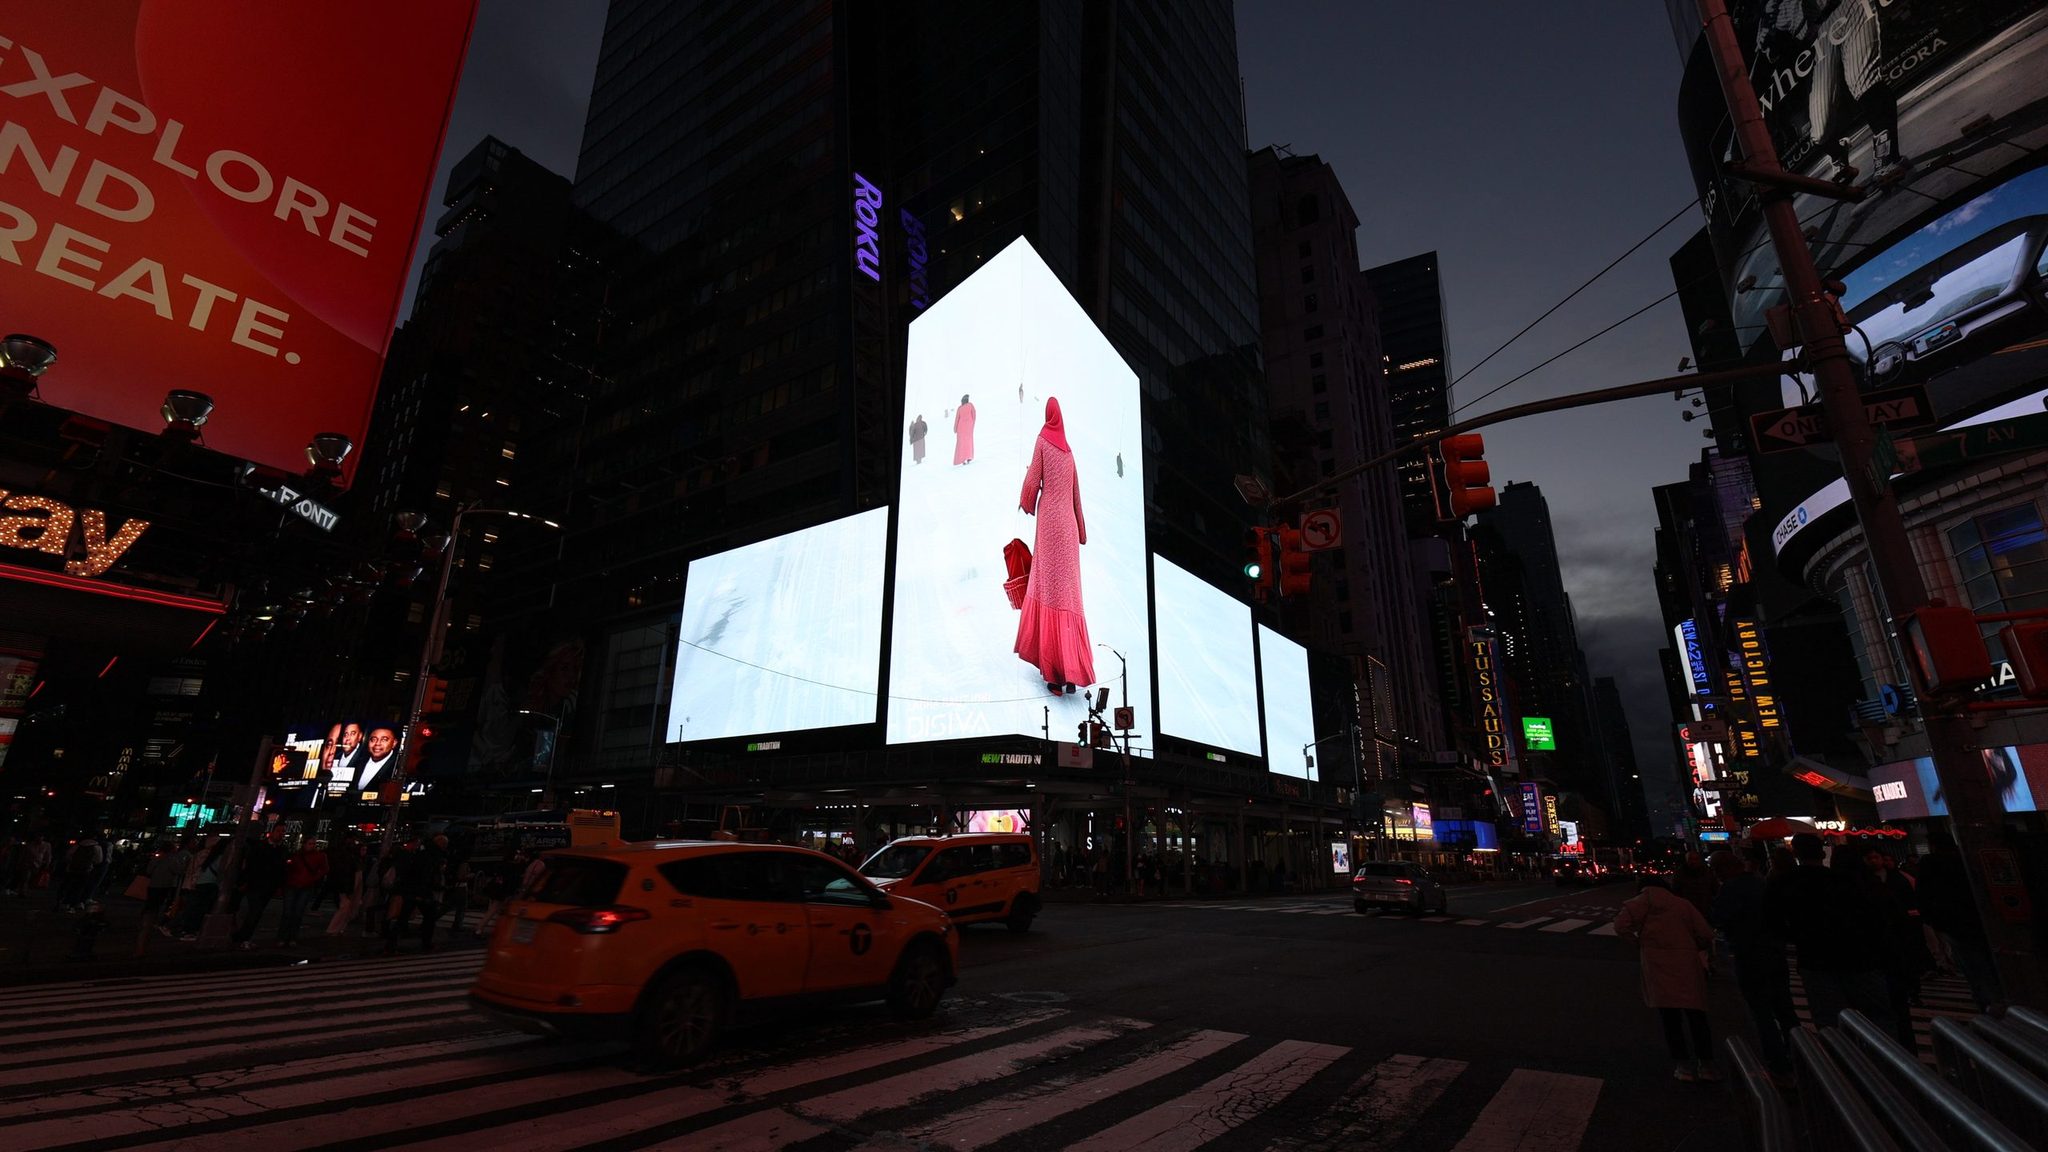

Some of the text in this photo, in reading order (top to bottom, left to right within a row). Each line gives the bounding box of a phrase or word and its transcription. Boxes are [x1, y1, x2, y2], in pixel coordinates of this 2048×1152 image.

[0, 35, 378, 258] XPLORE
[1865, 401, 1904, 425] AY
[0, 489, 152, 577] ay
[1776, 514, 1799, 545] CHASE
[1681, 618, 1698, 640] NEW
[1736, 620, 1780, 728] NEW VICTORY
[1740, 731, 1760, 757] NEW
